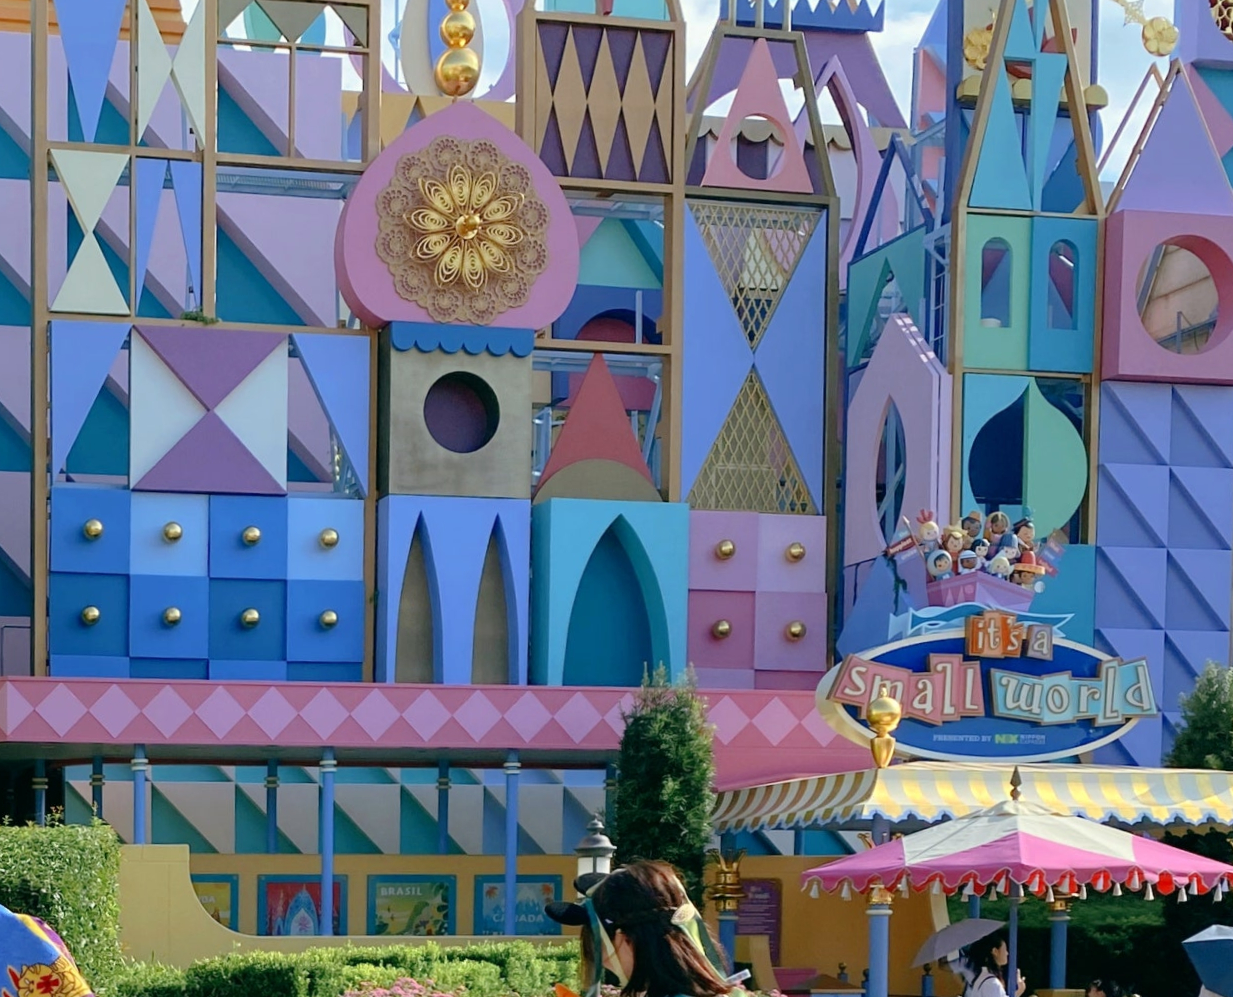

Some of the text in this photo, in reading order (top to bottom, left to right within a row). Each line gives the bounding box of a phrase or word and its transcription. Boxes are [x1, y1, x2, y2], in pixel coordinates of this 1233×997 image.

[977, 616, 1049, 655] it's a
[843, 662, 1153, 719] small world
[933, 734, 980, 742] PRESENTED
[981, 734, 992, 742] BY
[380, 886, 422, 896] BRASIL
